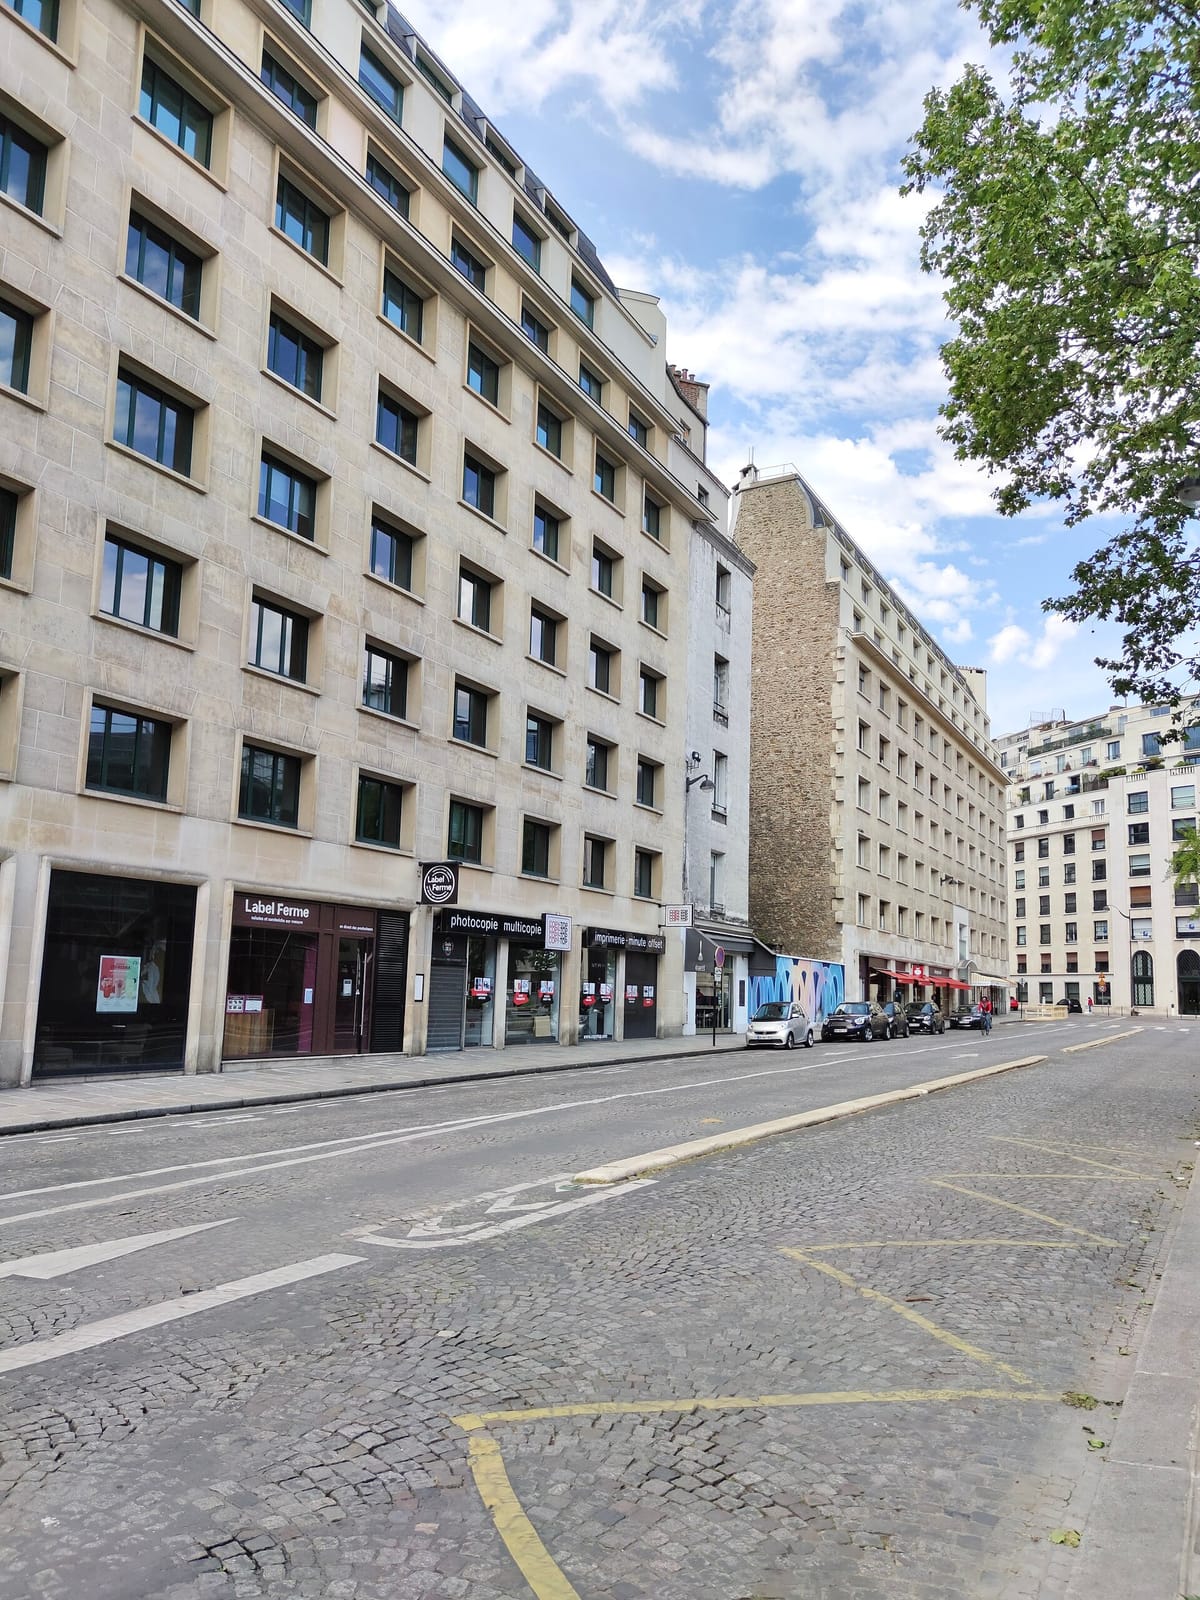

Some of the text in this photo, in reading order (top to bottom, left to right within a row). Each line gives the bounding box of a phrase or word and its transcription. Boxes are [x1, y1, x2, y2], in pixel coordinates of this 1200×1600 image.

[427, 875, 445, 883] Label
[432, 884, 452, 892] Ferme
[245, 899, 310, 919] Label Ferme
[450, 914, 542, 936] photocopie multicopie
[647, 938, 663, 949] offset
